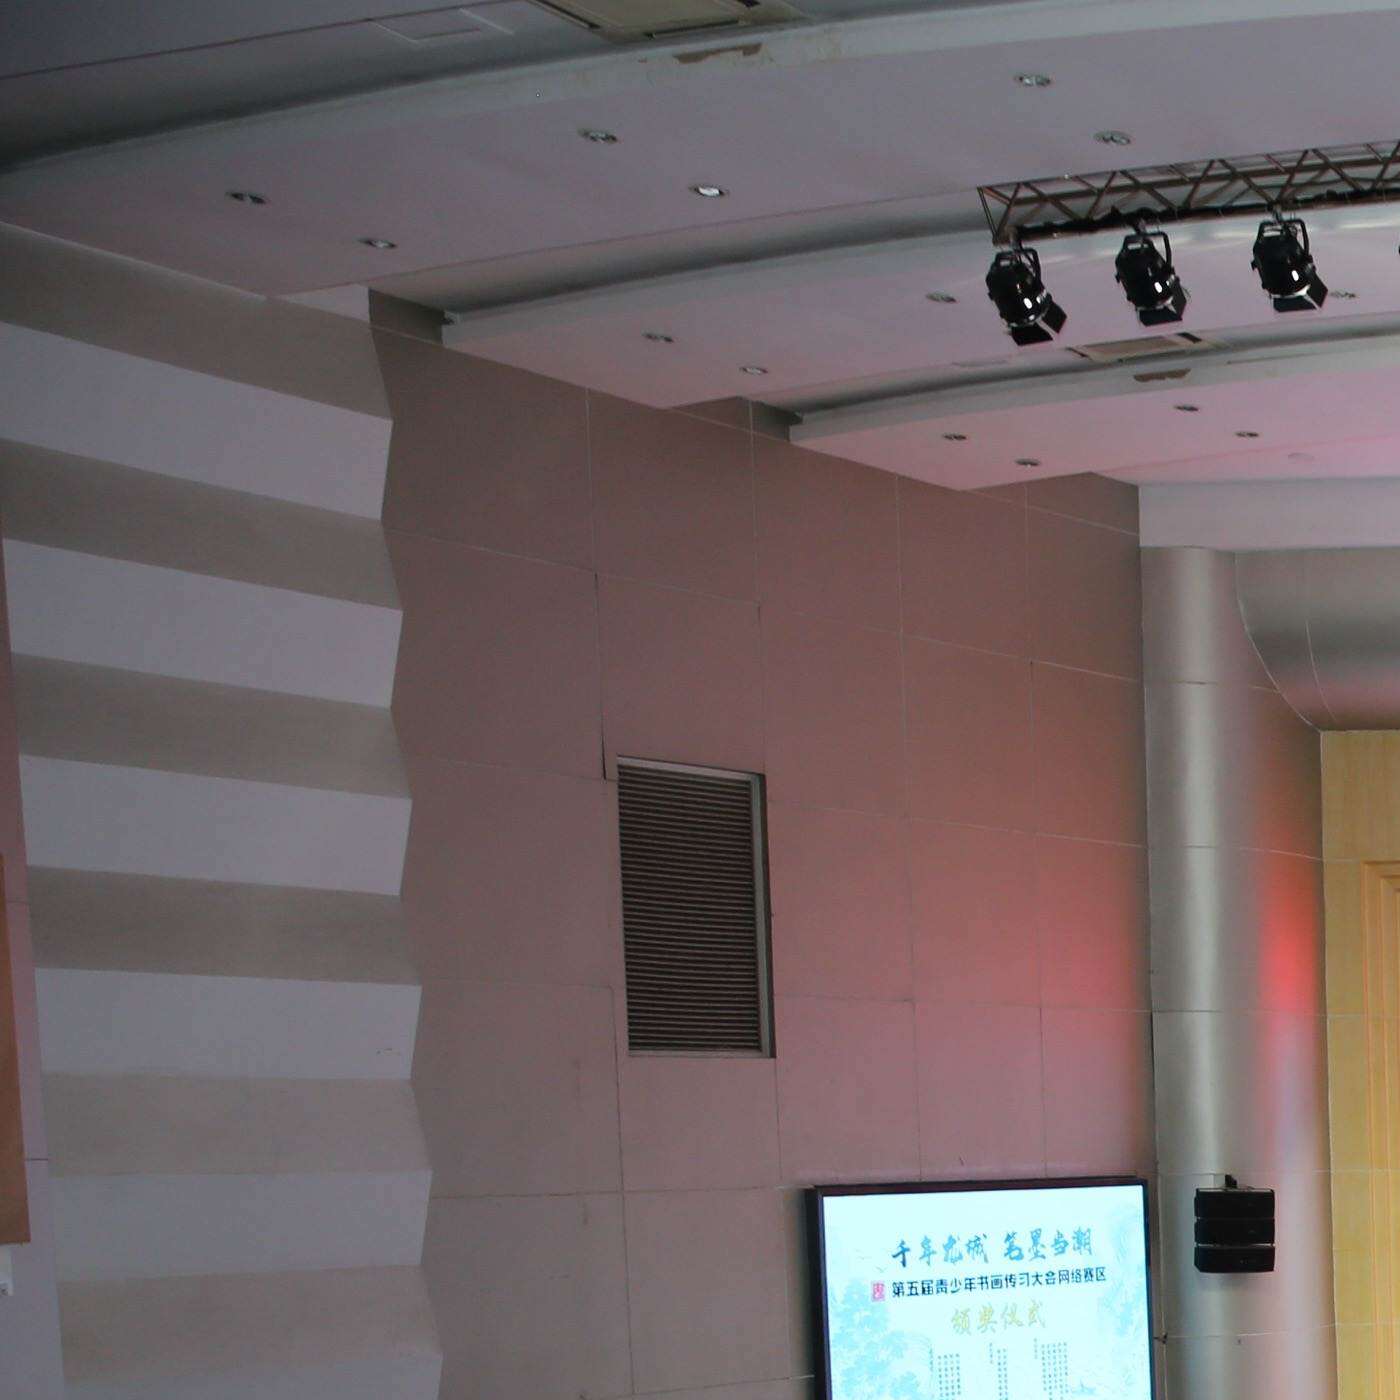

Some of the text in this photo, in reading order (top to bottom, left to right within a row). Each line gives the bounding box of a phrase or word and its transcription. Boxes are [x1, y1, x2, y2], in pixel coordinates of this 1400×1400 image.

[892, 1266, 1107, 1299] 第五届青少年书画传习大会网络赛区
[952, 1301, 1047, 1336] 颁奖仪式
